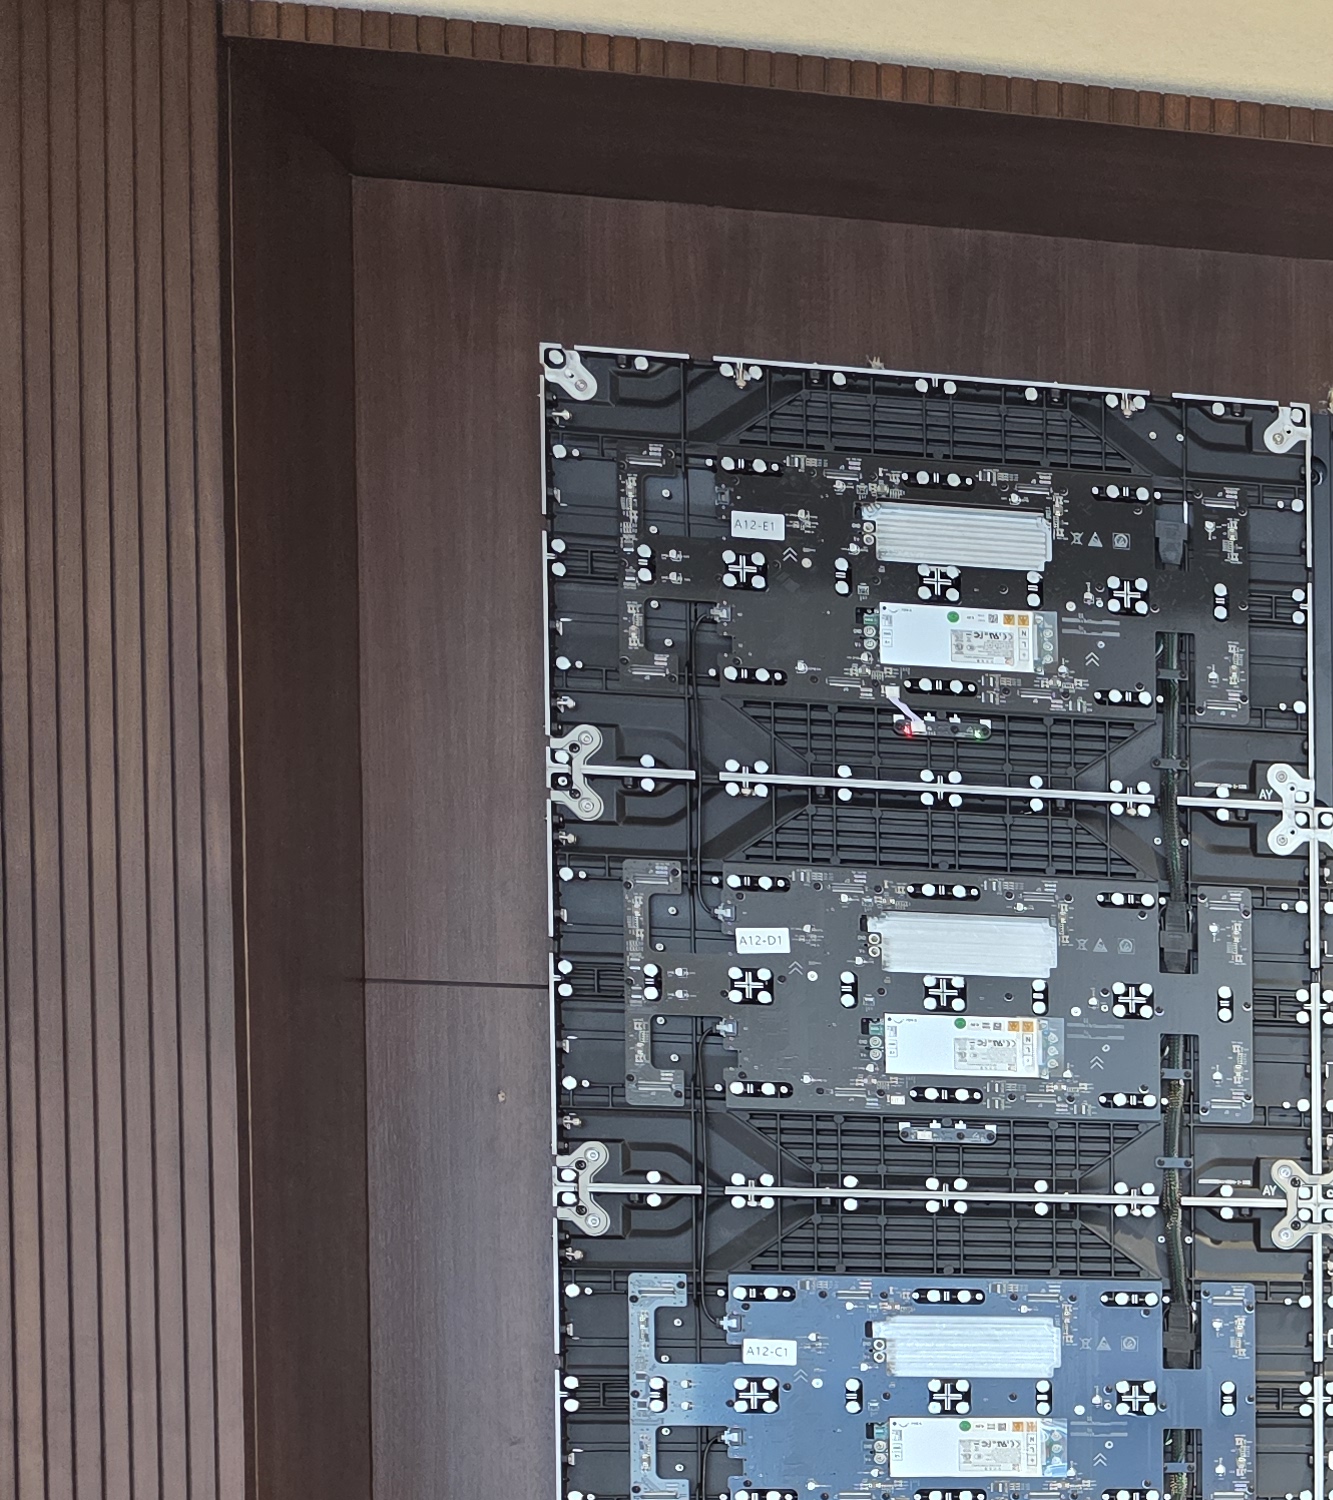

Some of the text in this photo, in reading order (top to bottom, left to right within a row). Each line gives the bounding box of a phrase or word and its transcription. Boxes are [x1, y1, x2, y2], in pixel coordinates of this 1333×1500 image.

[734, 519, 776, 533] A12-E1
[1259, 789, 1273, 799] AY
[739, 935, 782, 946] A12-D1
[1262, 1185, 1277, 1195] AY
[746, 1346, 788, 1358] A12-C1
